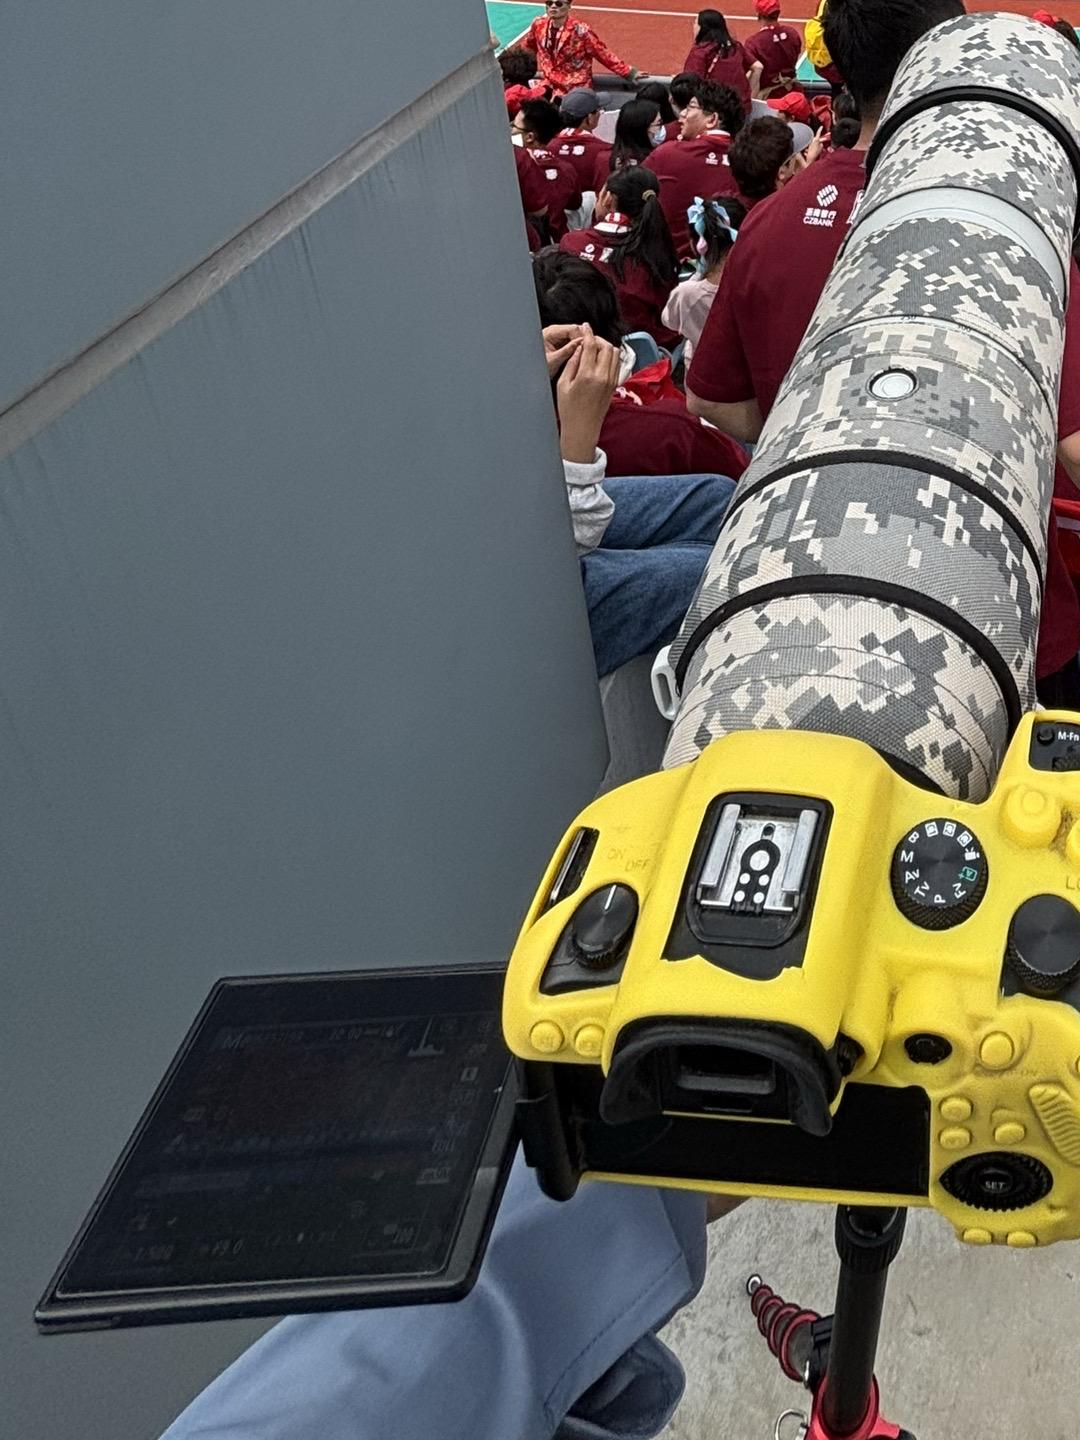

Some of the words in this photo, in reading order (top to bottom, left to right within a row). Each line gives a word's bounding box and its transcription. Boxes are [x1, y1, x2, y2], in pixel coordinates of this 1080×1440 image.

[803, 216, 834, 228] CZBANK
[1057, 730, 1080, 742] M-Fn
[908, 831, 920, 844] B
[900, 850, 914, 863] M
[905, 868, 920, 884] Av
[914, 881, 930, 898] Tv
[933, 894, 946, 904] P
